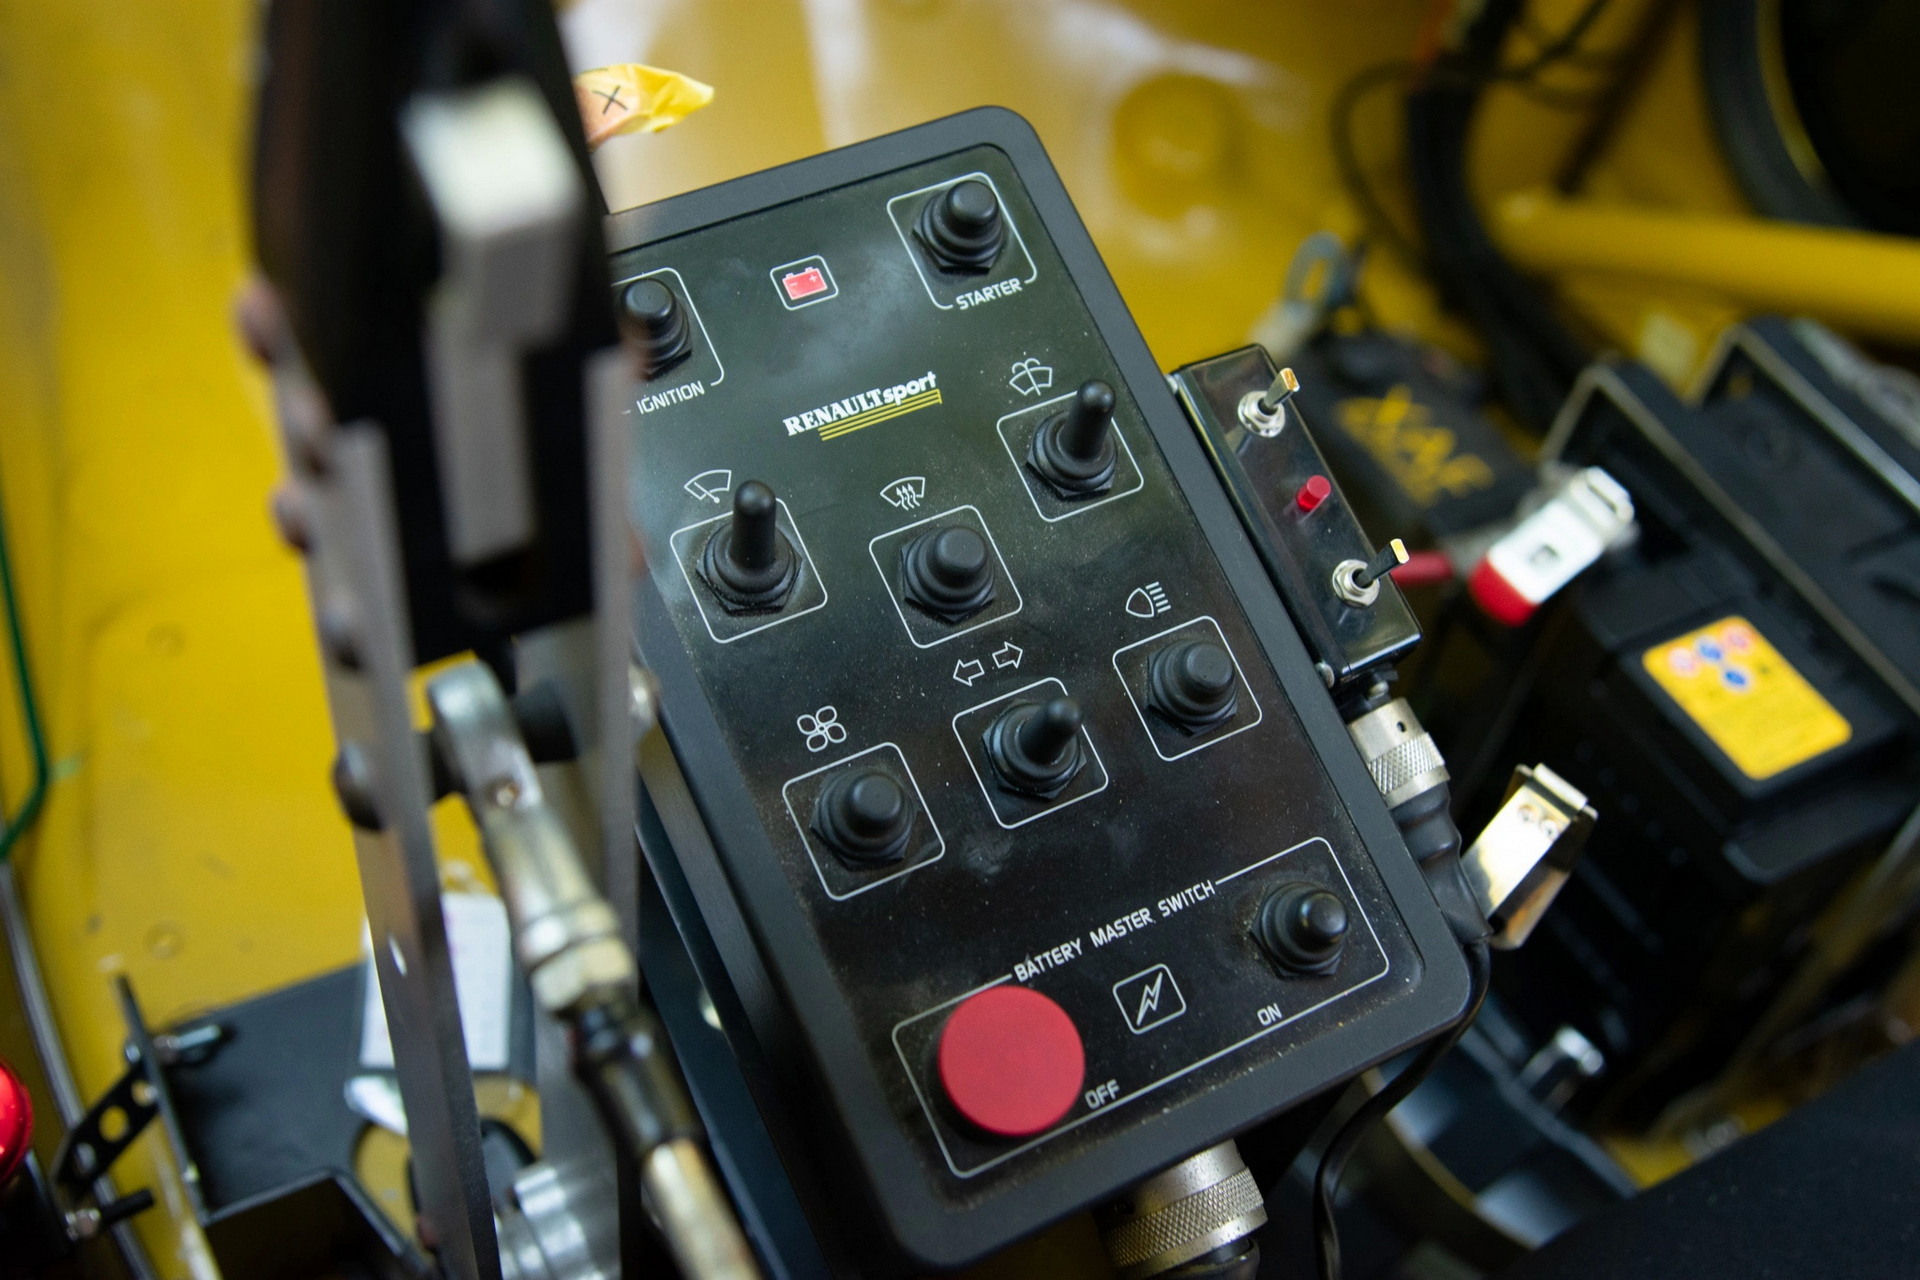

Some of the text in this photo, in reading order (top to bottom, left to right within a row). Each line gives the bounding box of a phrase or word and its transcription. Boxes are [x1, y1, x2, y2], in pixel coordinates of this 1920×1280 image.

[956, 277, 1022, 311] STARTER
[637, 381, 705, 415] IGNITION
[1013, 879, 1216, 983] BATTERY MASTER SWITCH
[1257, 1003, 1283, 1027] ON
[1085, 1079, 1120, 1110] OFF
